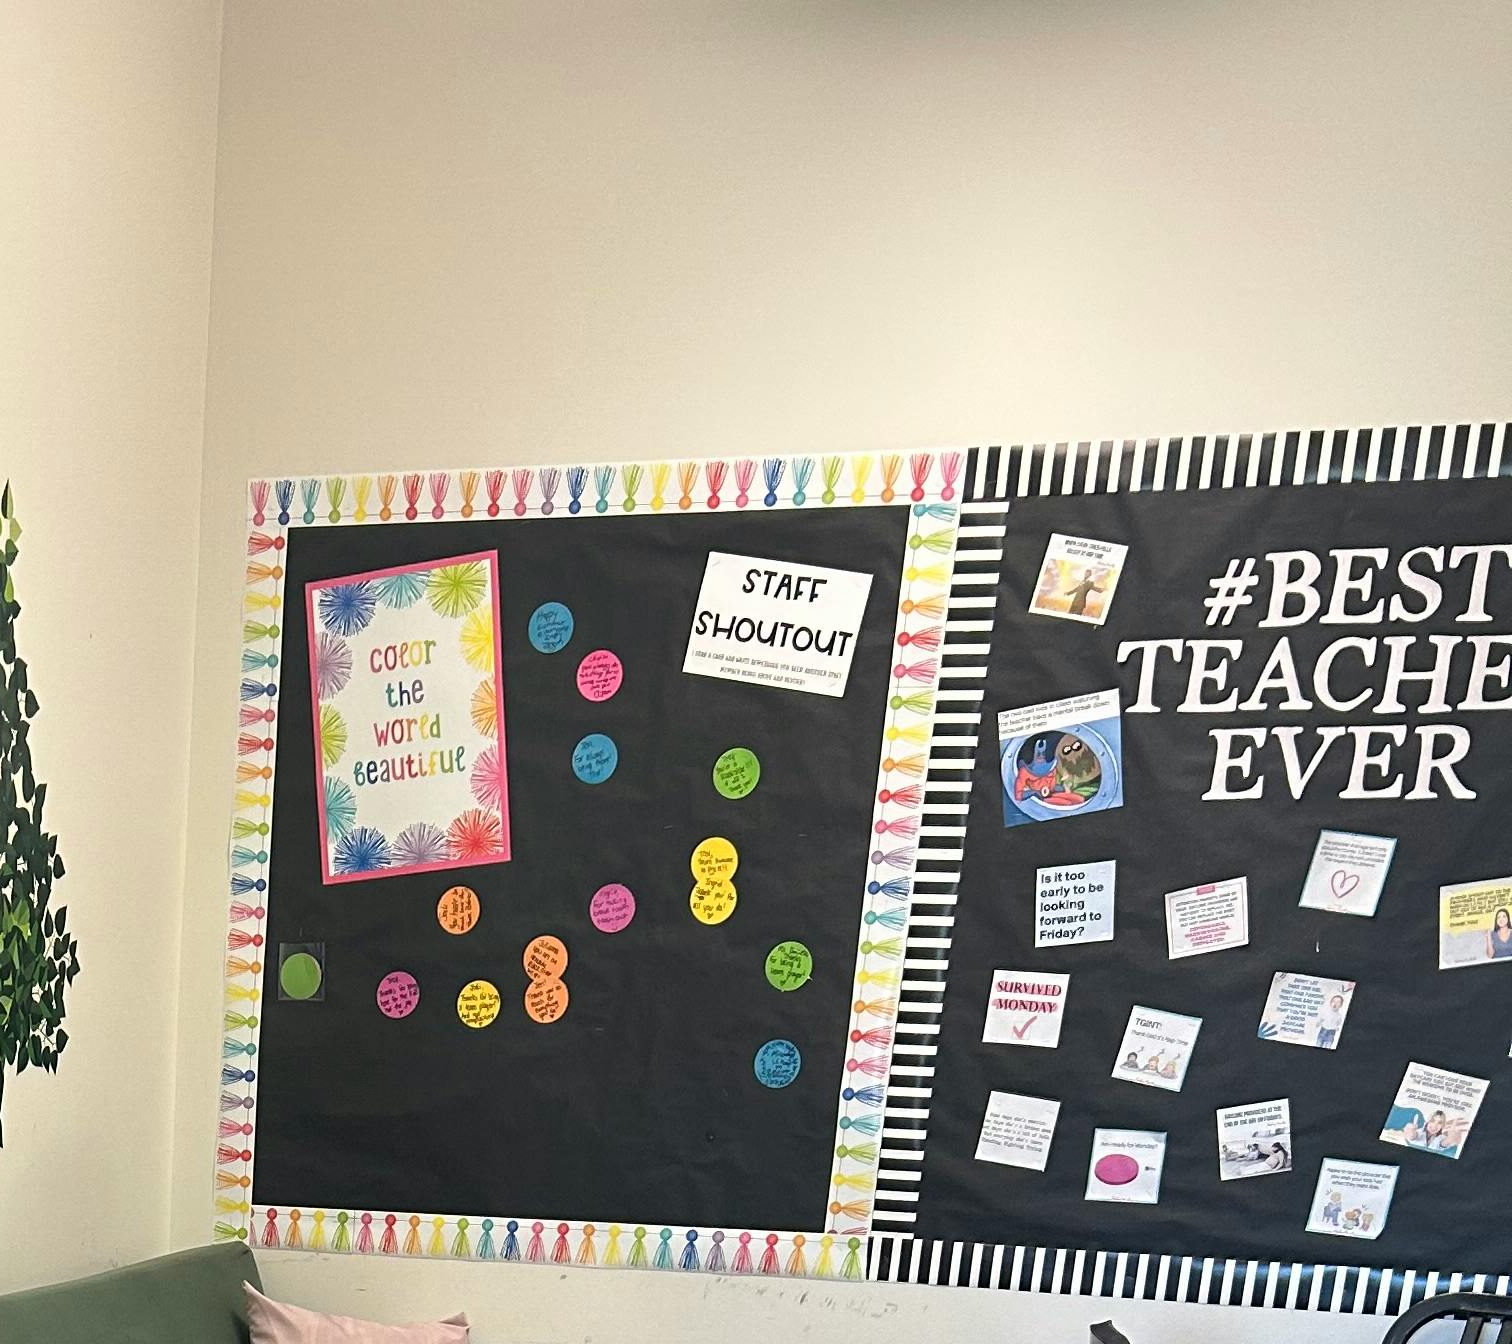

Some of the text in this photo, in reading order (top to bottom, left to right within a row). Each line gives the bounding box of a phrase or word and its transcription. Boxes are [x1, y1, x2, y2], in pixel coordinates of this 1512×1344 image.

[742, 568, 828, 603] STAFF
[1203, 543, 1512, 628] #BEST
[695, 610, 853, 657] SHOUTOUT
[370, 639, 437, 674] color
[386, 679, 424, 709] the
[373, 713, 441, 747] world
[1201, 725, 1477, 801] EVER
[1041, 871, 1086, 884] Is it too
[1040, 883, 1104, 898] early to be
[1040, 900, 1085, 912] looking
[1039, 912, 1102, 926] forward to
[1039, 926, 1085, 940] Friday?
[997, 980, 1062, 997] SURVIVED
[995, 998, 1055, 1013] MONDAY
